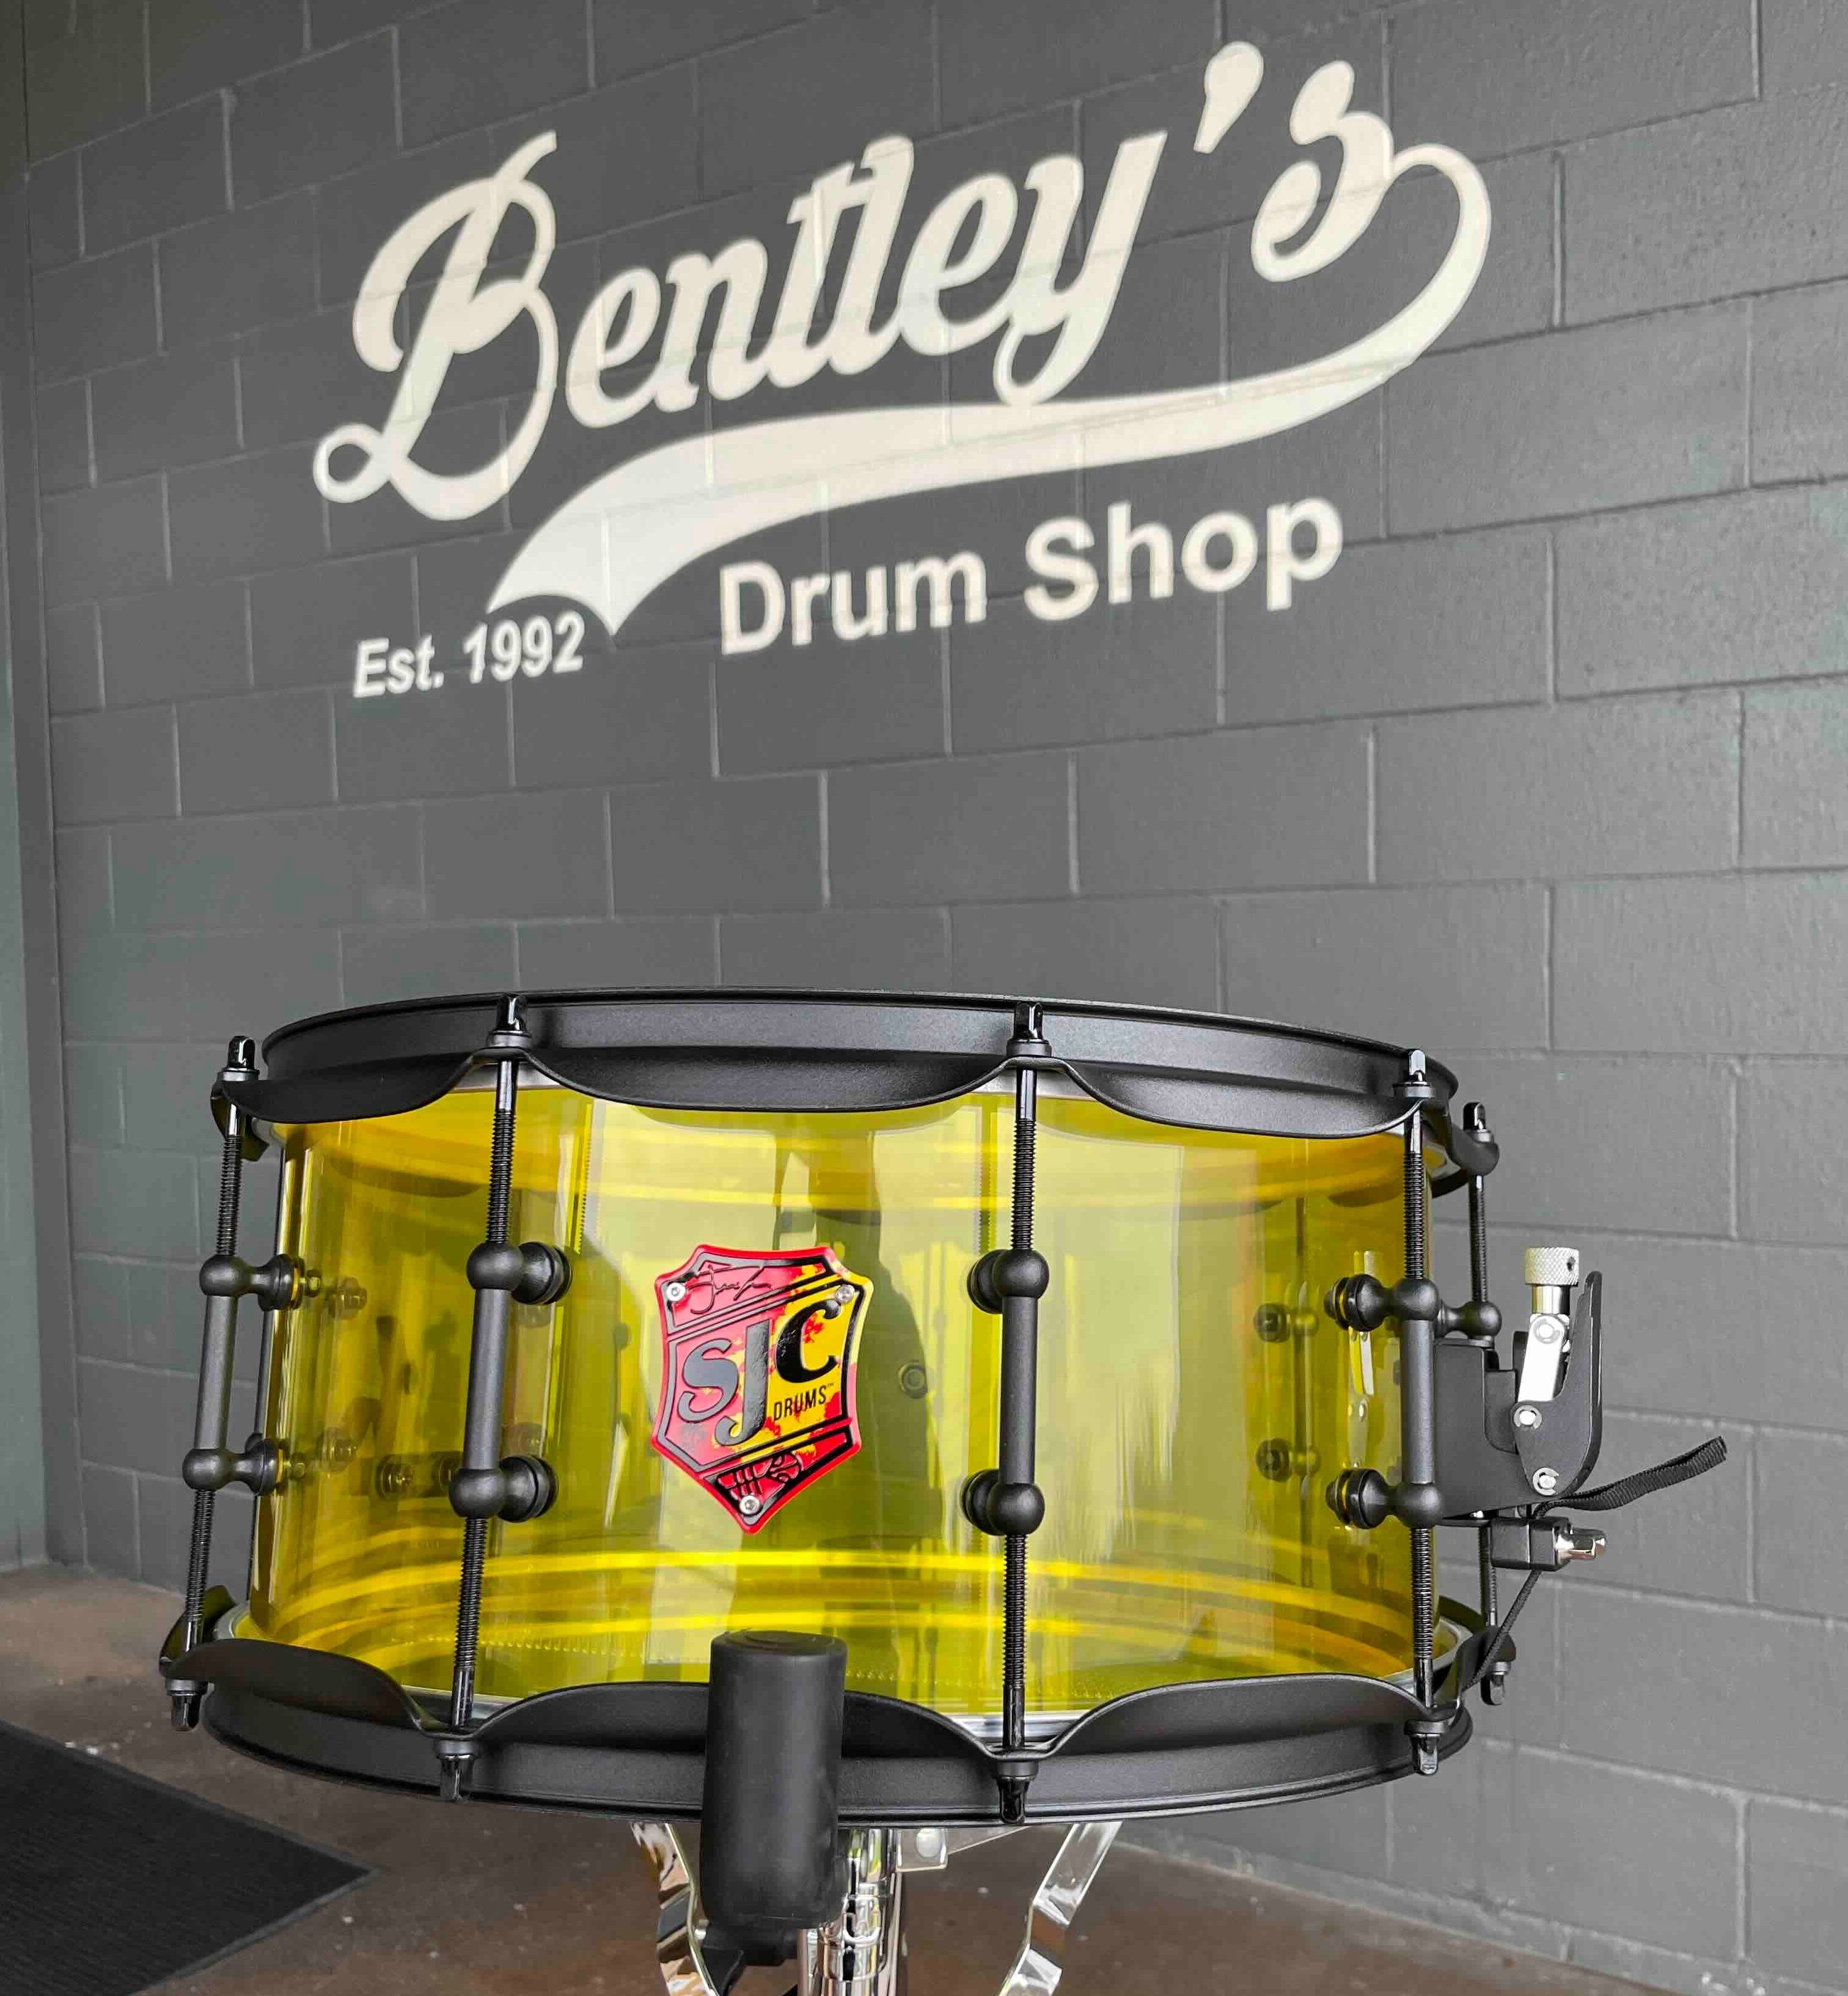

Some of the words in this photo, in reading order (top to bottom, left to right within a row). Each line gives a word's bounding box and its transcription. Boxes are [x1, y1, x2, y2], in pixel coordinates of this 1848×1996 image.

[312, 41, 1492, 521] Bentley's
[719, 551, 988, 655] Drum
[1024, 497, 1343, 621] Shop
[353, 634, 444, 698] Est.
[463, 610, 585, 684] 1992
[676, 1299, 843, 1447] SJC
